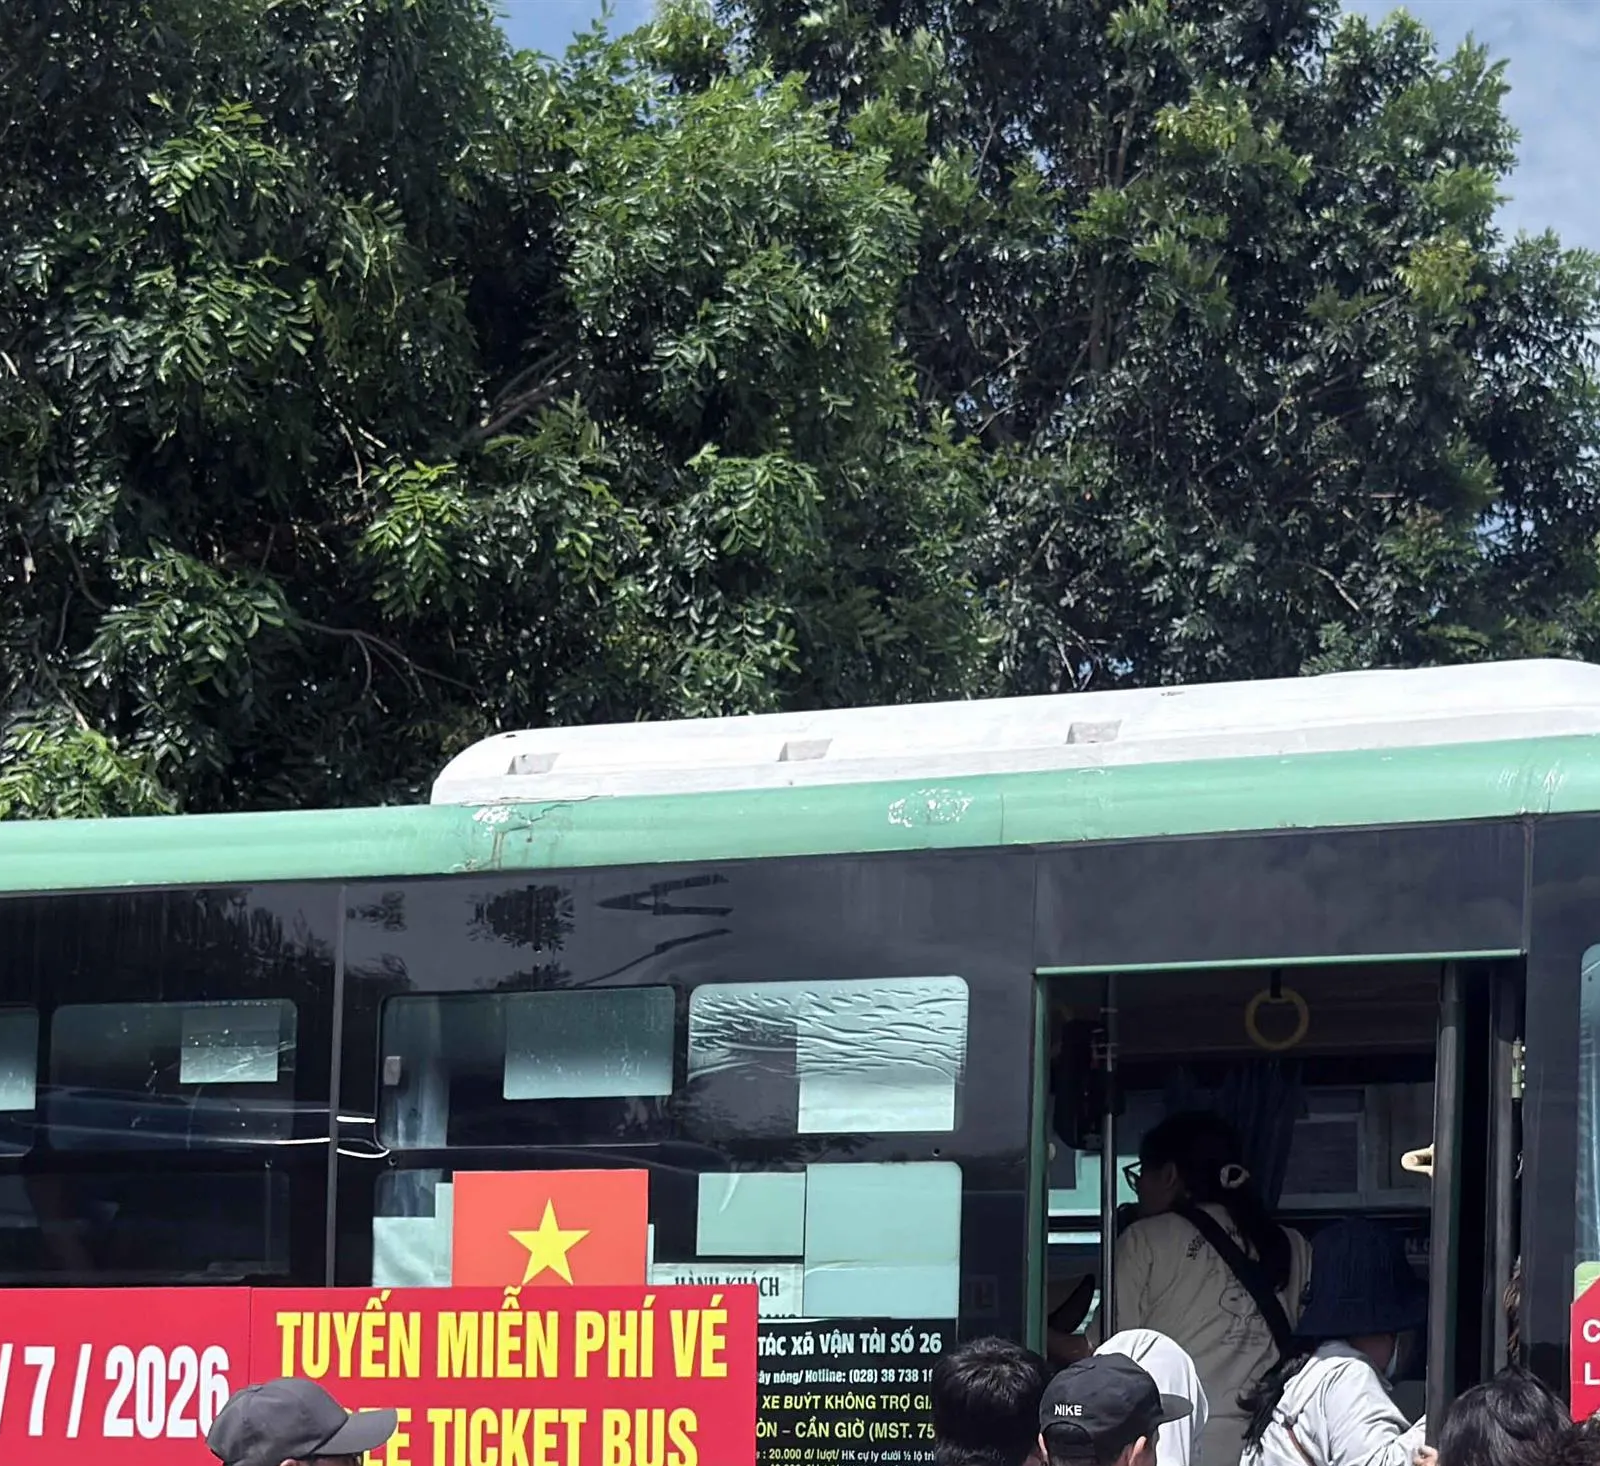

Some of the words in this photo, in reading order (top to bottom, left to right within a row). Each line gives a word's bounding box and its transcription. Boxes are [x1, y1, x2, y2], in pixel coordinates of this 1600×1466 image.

[276, 1289, 421, 1378] TUYẾN
[437, 1286, 558, 1378] MIỄN
[574, 1294, 656, 1378] PHÍ
[670, 1294, 728, 1377] VÉ
[758, 1332, 786, 1356] TÁC
[791, 1331, 815, 1356] XÃ
[819, 1328, 855, 1358] VẬN
[859, 1326, 886, 1354] TẢI
[890, 1326, 915, 1354] SỐ
[919, 1332, 942, 1354] 26
[758, 1370, 771, 1385] ây
[805, 1368, 846, 1383] Hotline:
[849, 1368, 878, 1384] (028)
[881, 1368, 896, 1383] 38
[898, 1368, 919, 1383] 738
[24, 1346, 56, 1436] 7
[103, 1345, 230, 1439] 2026
[761, 1395, 780, 1409] XE
[783, 1391, 821, 1409] BUÝT
[825, 1391, 876, 1410] KHÔNG
[880, 1393, 910, 1412] TRỢ
[914, 1395, 932, 1410] GI
[1054, 1403, 1083, 1416] NIKE
[756, 1417, 778, 1438] ÒN
[835, 1418, 864, 1438] GIỜ
[868, 1422, 913, 1442] (MST.
[769, 1448, 801, 1460] 20.000
[841, 1450, 855, 1460] HK
[871, 1450, 879, 1463] ly
[924, 1450, 934, 1461] trì
